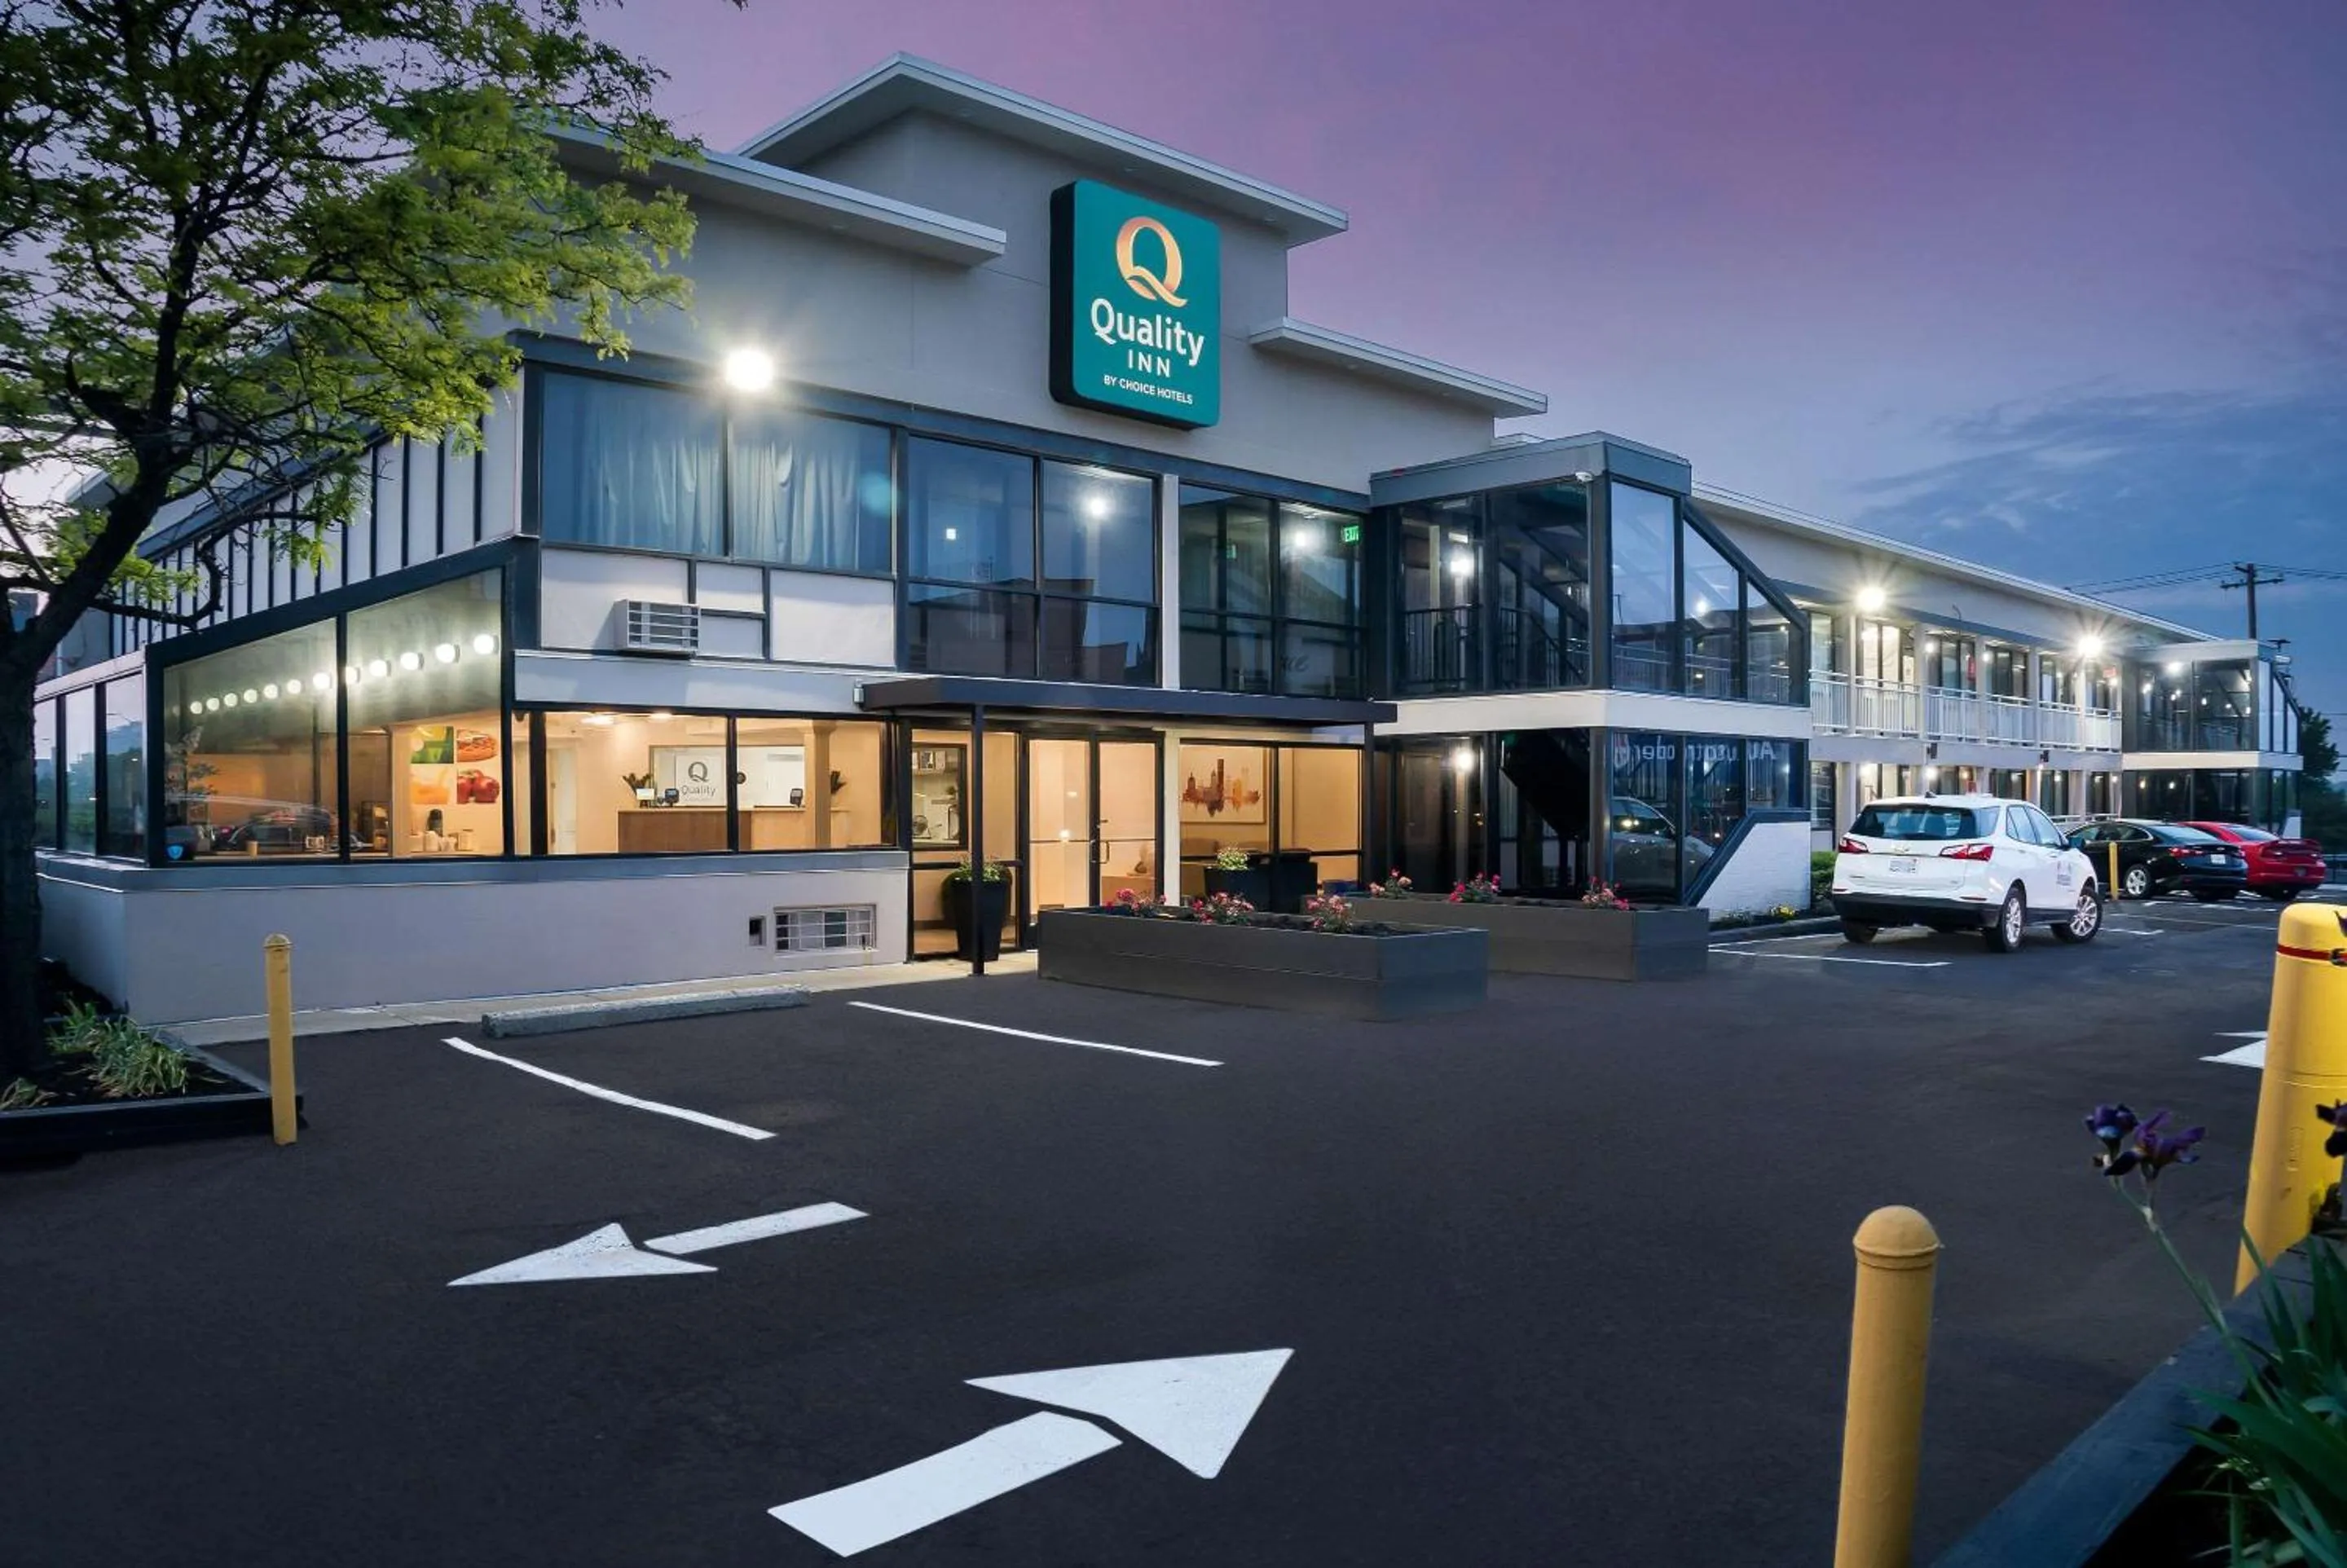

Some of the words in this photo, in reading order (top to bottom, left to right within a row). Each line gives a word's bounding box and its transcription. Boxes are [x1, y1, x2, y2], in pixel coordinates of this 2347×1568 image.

[1116, 216, 1188, 307] Q
[1090, 298, 1204, 366] Quality
[1129, 350, 1170, 377] INN
[1103, 375, 1117, 386] BY
[1120, 378, 1156, 396] CHOICE
[1157, 387, 1194, 405] HOTELS
[1345, 526, 1359, 542] EXIT
[689, 762, 710, 782] Q
[681, 786, 716, 797] Quality
